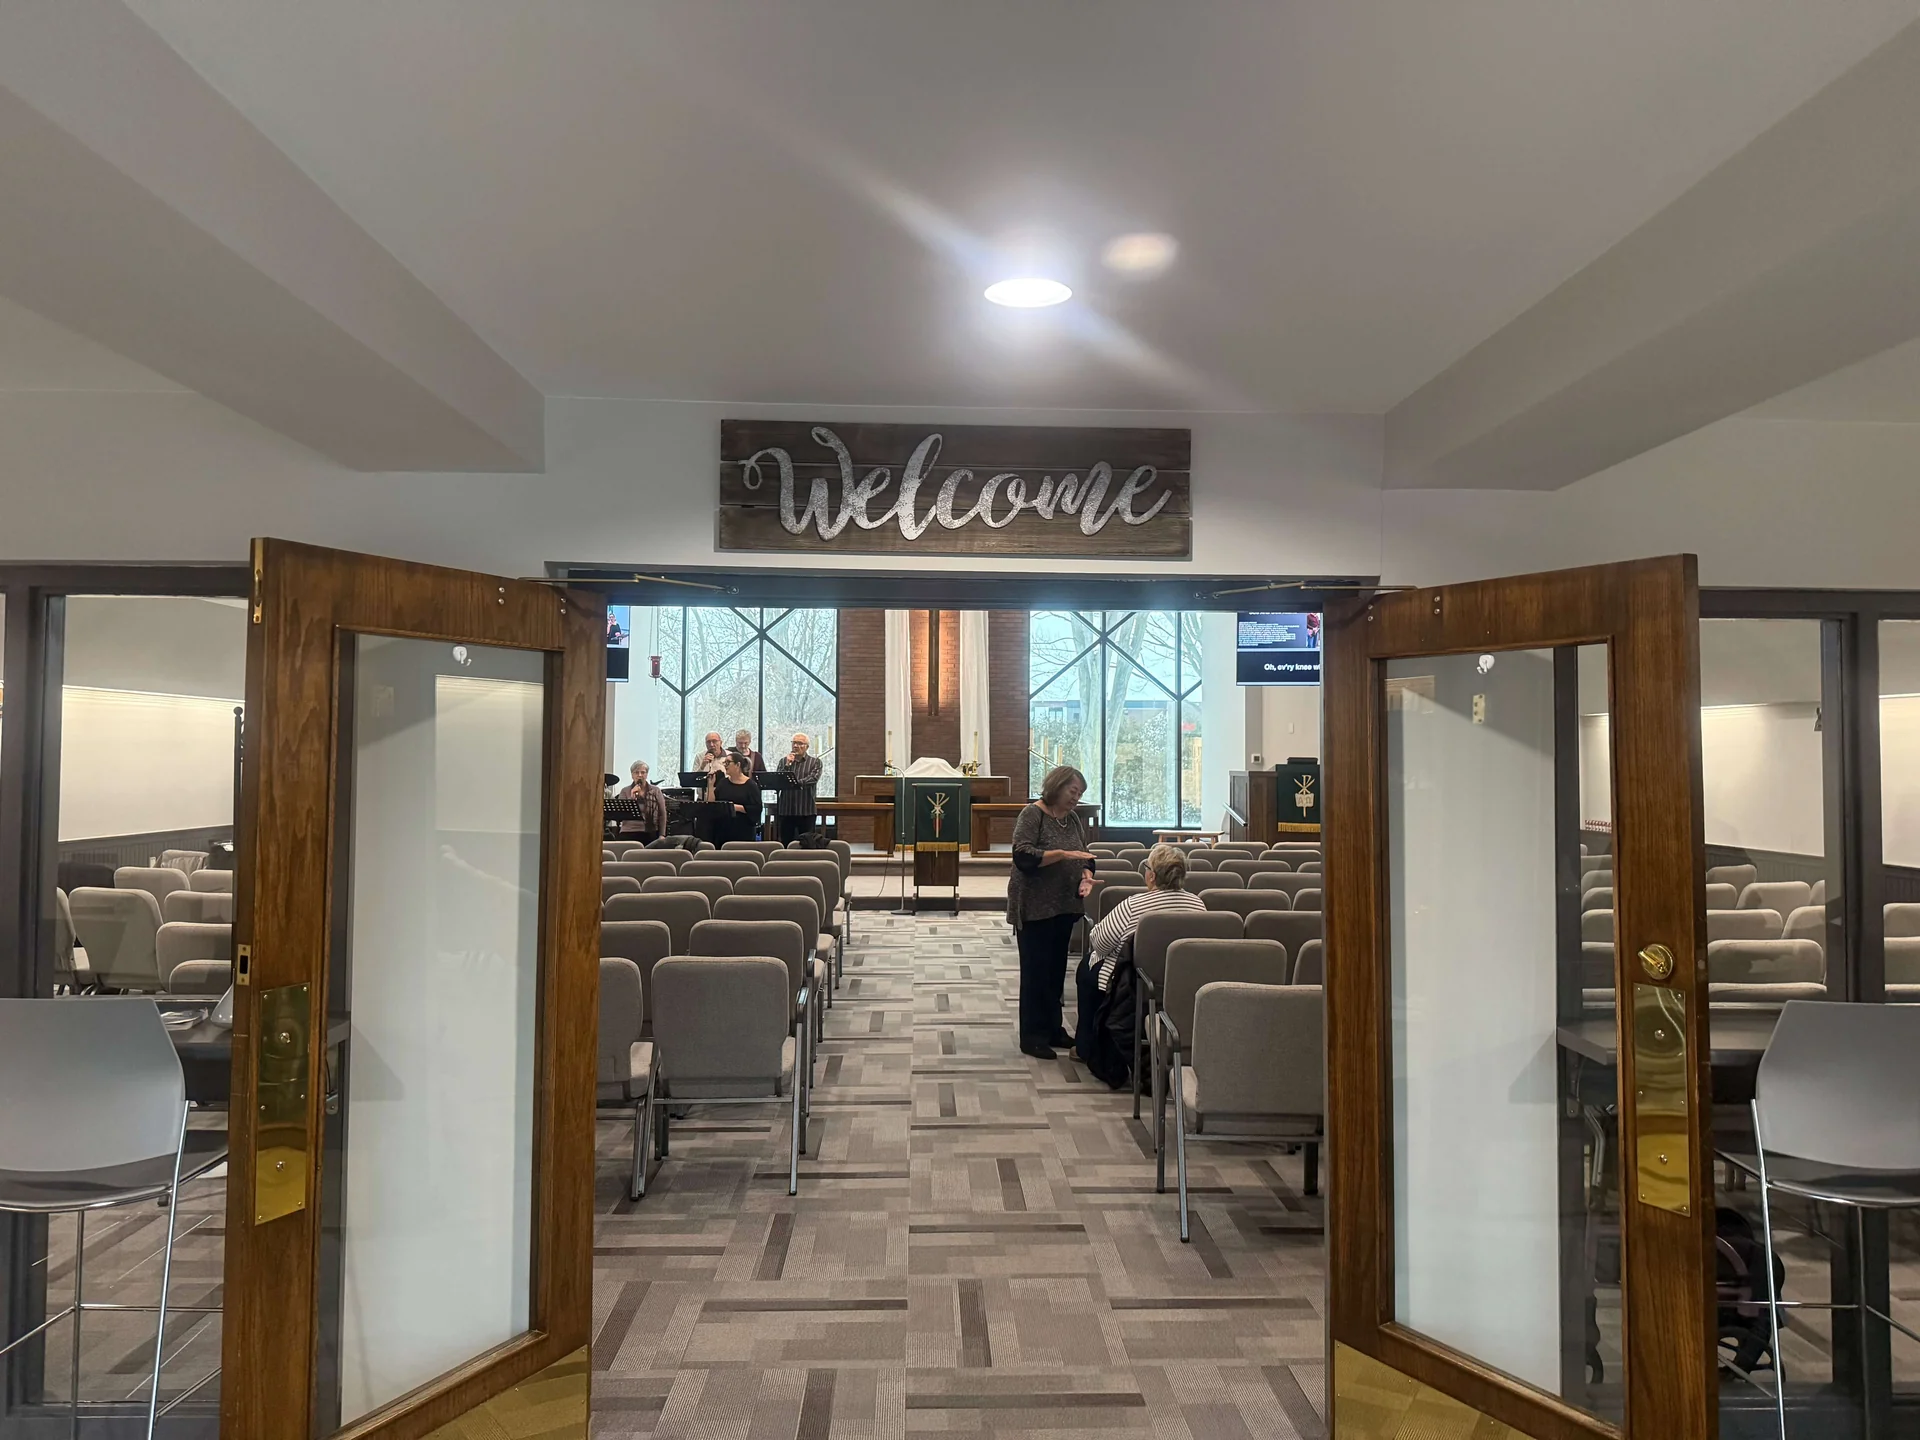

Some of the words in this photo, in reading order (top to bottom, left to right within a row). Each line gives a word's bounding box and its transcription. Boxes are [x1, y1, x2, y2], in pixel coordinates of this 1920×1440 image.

[739, 427, 1172, 541] Welcome
[1264, 663, 1276, 671] Oh,
[1295, 663, 1312, 671] knee
